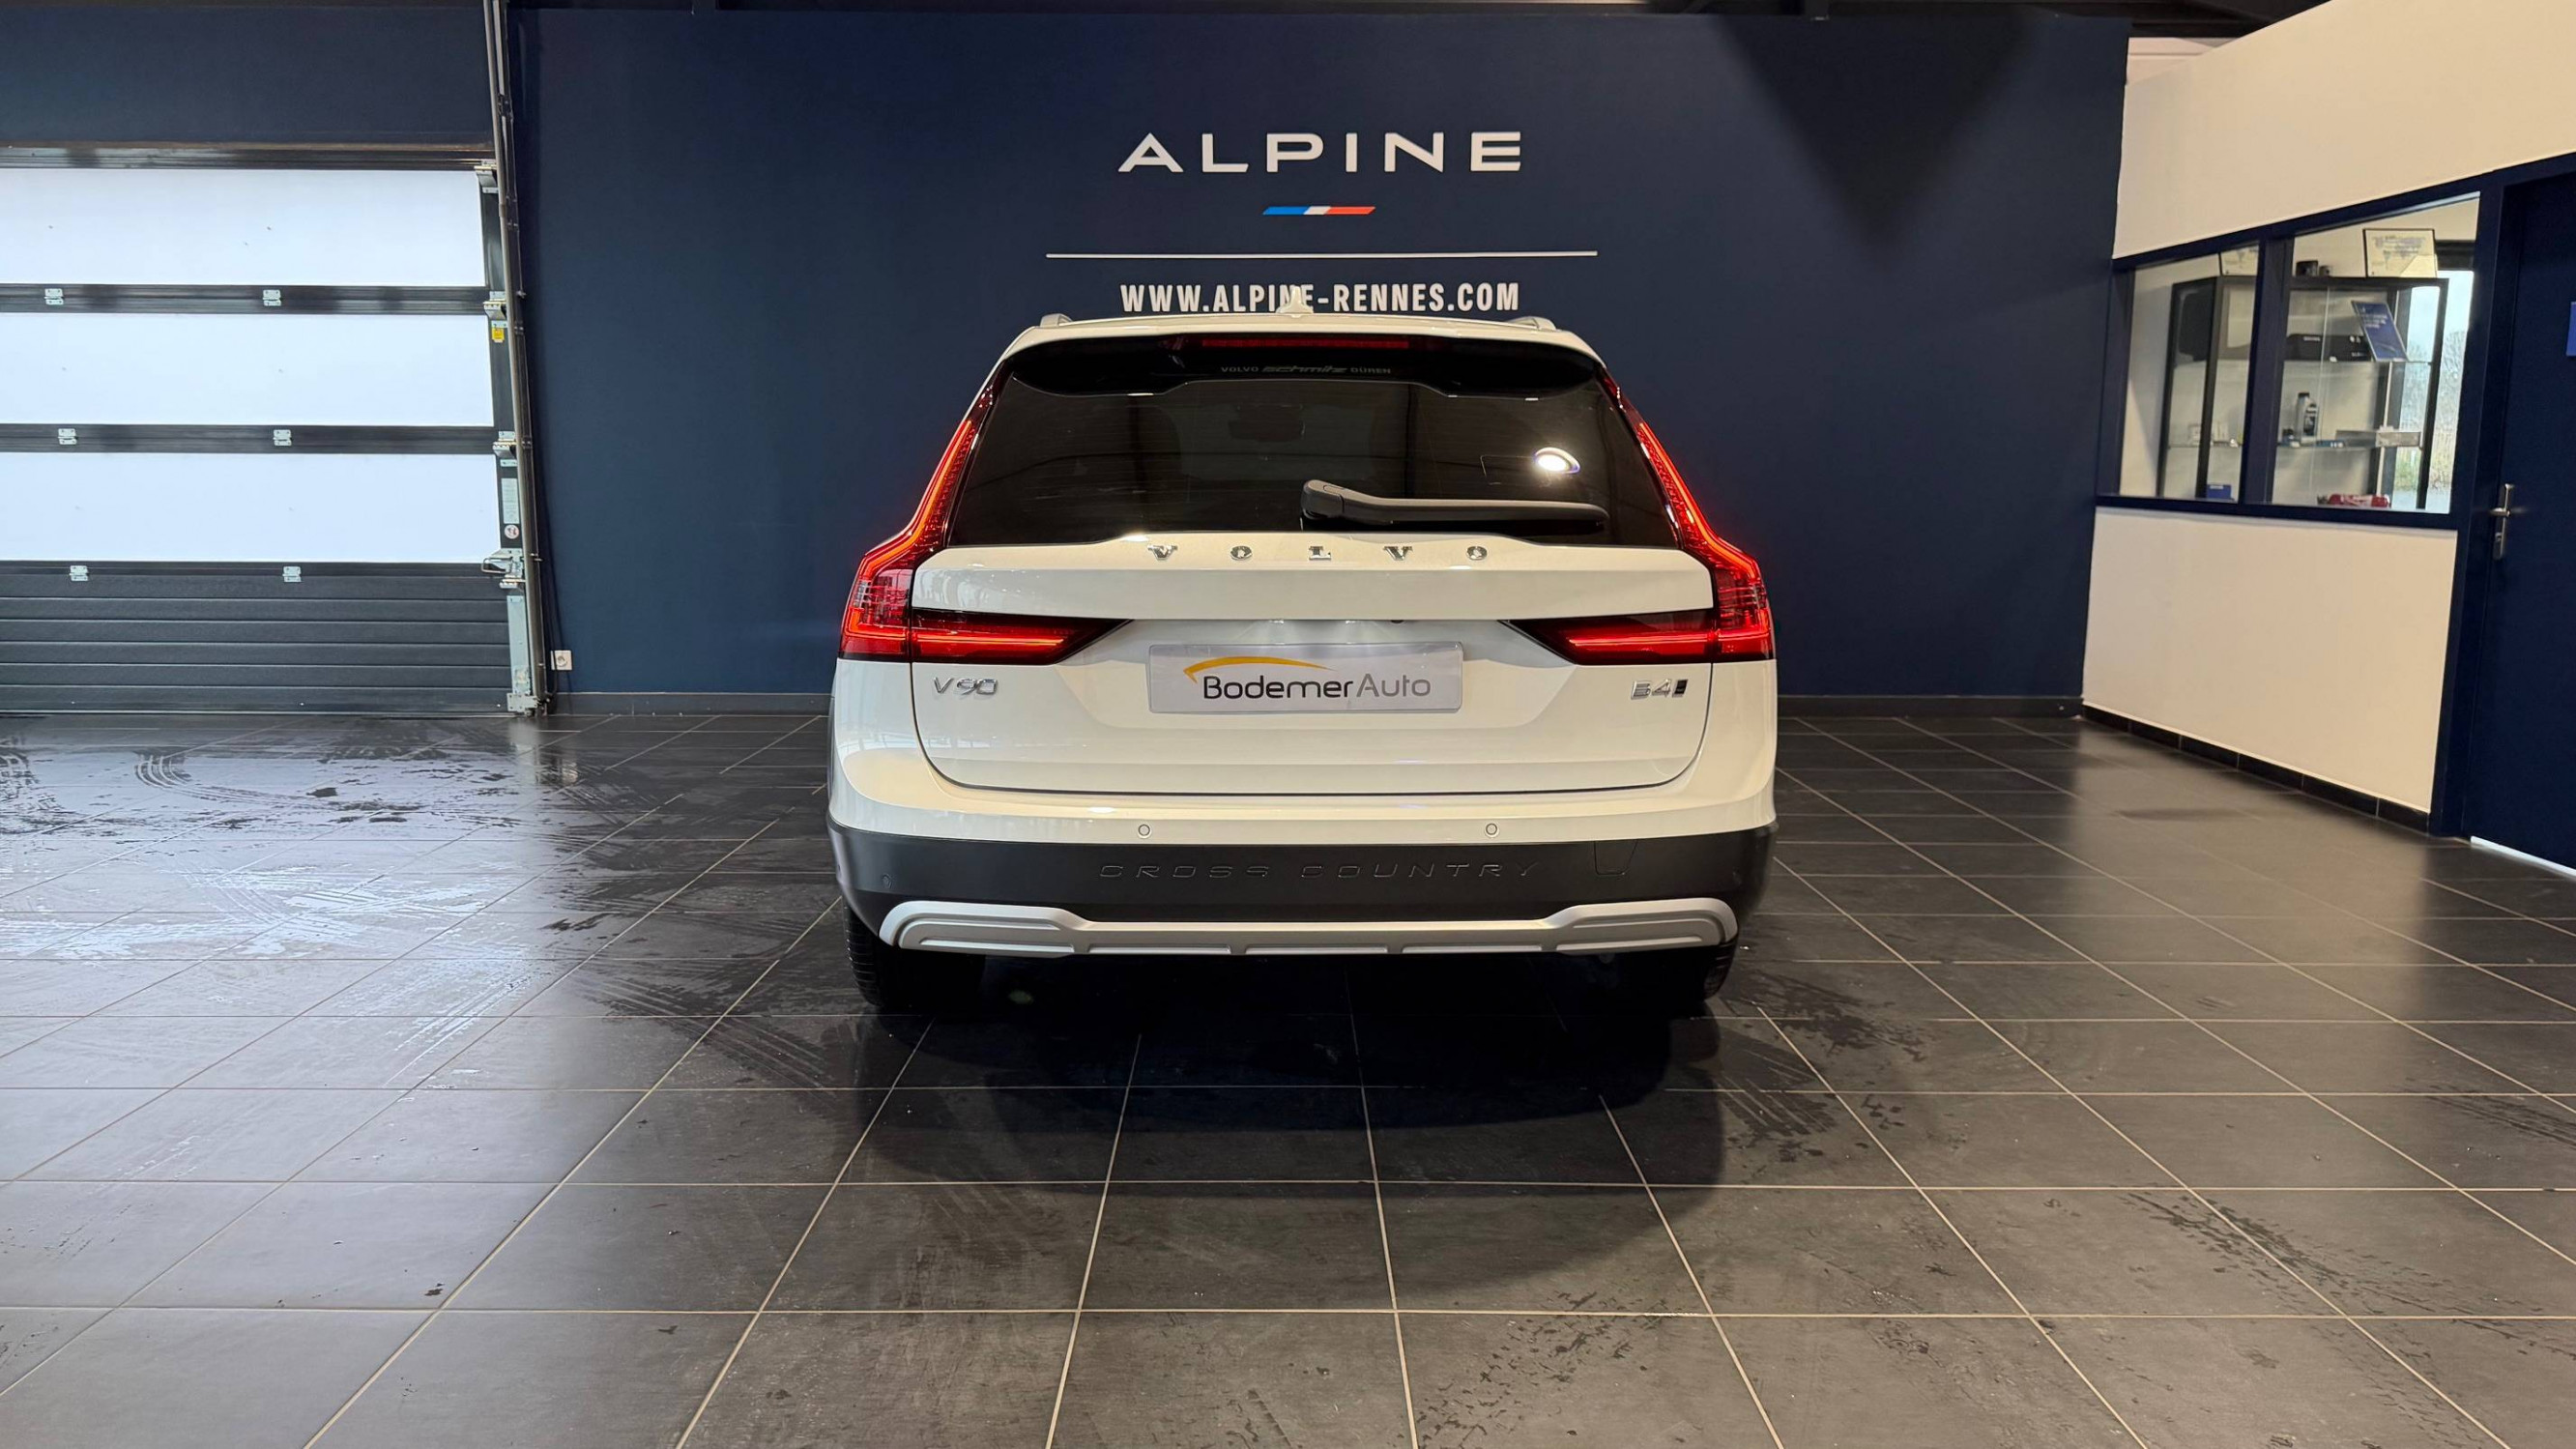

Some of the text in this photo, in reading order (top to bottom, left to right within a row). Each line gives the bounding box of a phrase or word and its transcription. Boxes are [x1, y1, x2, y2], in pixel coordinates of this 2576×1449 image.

[1117, 130, 1522, 173] ALPINE
[1147, 544, 1488, 561] VOLVO
[934, 677, 998, 695] V90
[1631, 679, 1671, 700] B4
[1100, 863, 1540, 879] CROSS COUNTRY
